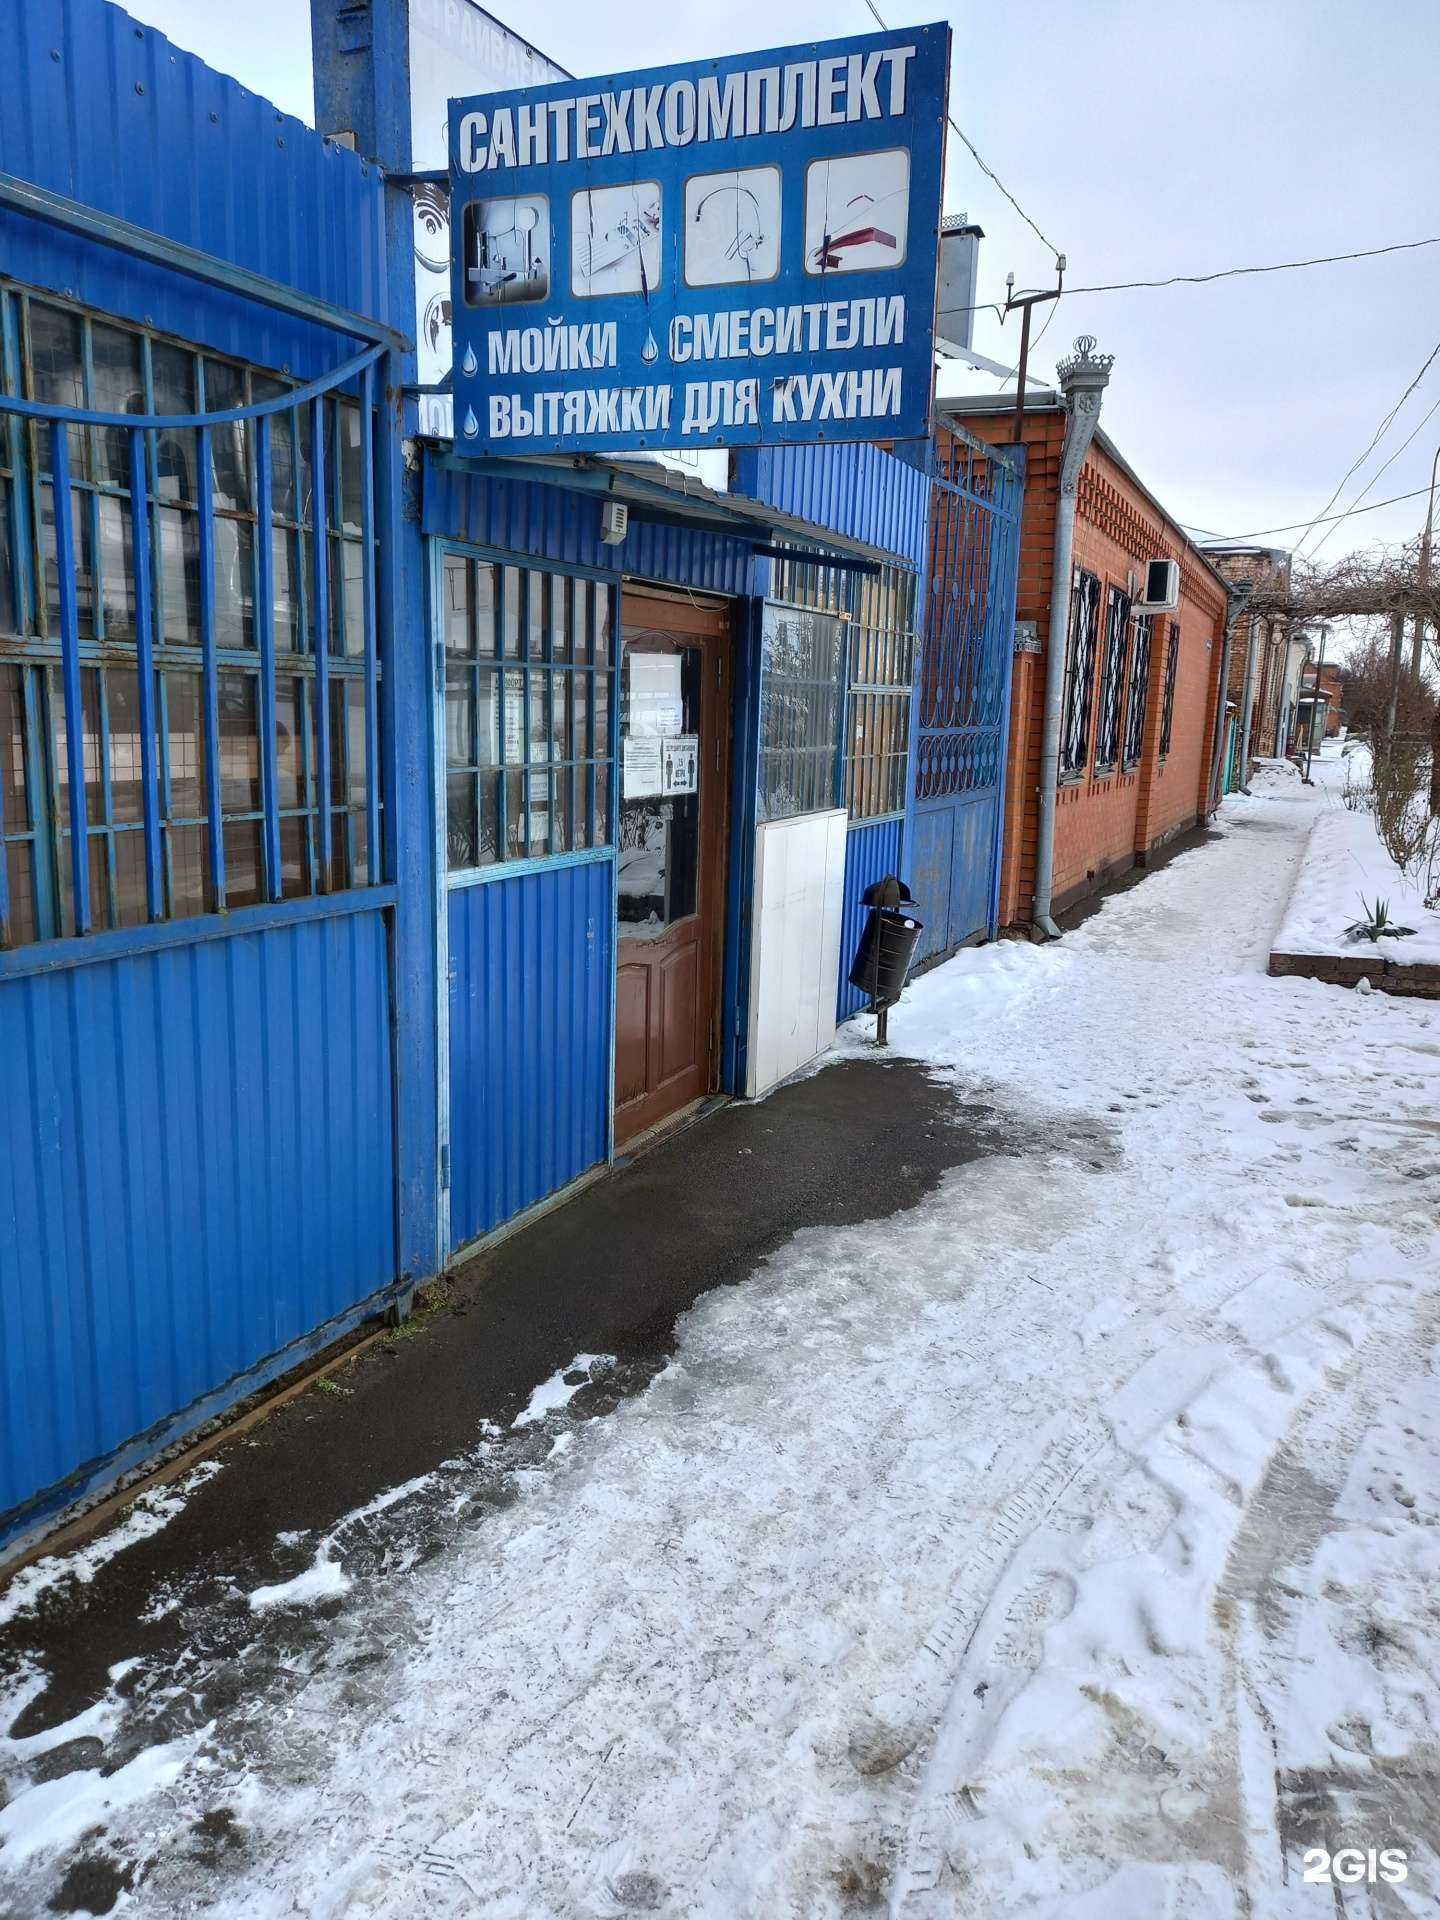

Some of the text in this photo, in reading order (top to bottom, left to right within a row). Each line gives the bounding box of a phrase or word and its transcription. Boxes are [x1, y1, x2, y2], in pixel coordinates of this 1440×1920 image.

[459, 46, 917, 174] САНТЕХКОМПЛЕКТ
[488, 295, 906, 376] МОЙКИ СМЕСИТЕЛИ
[489, 386, 673, 440] ВЫТЯЖКИ
[682, 378, 760, 436] ДЛЯ
[772, 367, 903, 425] КУХНИ
